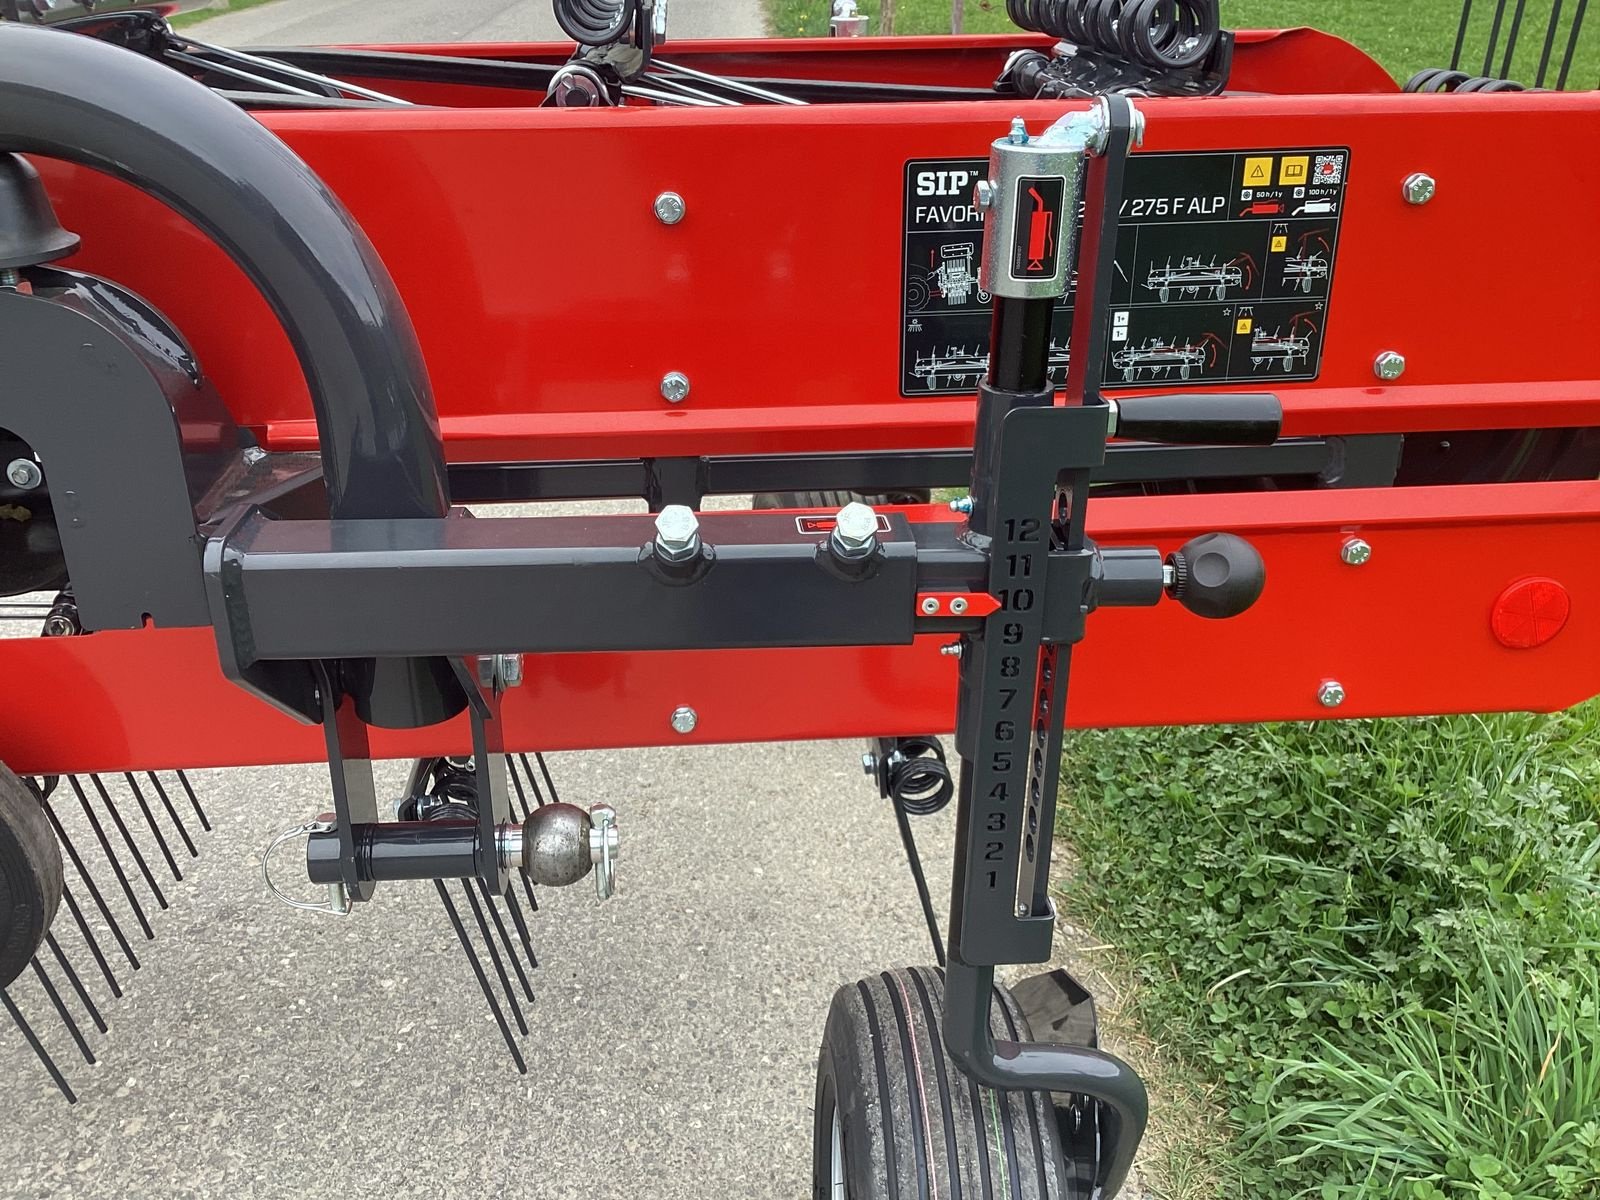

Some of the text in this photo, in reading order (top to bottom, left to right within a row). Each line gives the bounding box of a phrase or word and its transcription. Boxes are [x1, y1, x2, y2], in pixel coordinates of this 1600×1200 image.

[916, 171, 969, 196] SIP
[1131, 198, 1169, 216] 275
[1172, 197, 1186, 215] F
[1187, 196, 1226, 214] ALP
[1004, 518, 1040, 542] 12
[1005, 553, 1032, 578] 11
[998, 588, 1034, 612] 10
[1003, 622, 1024, 645] 9
[1000, 655, 1021, 679] 8
[998, 688, 1018, 710] 7
[994, 719, 1016, 742] 6
[992, 751, 1012, 773] 5
[988, 781, 1009, 802] 4
[986, 812, 1007, 833] 3
[984, 841, 1004, 861] 2
[986, 869, 997, 890] 1
